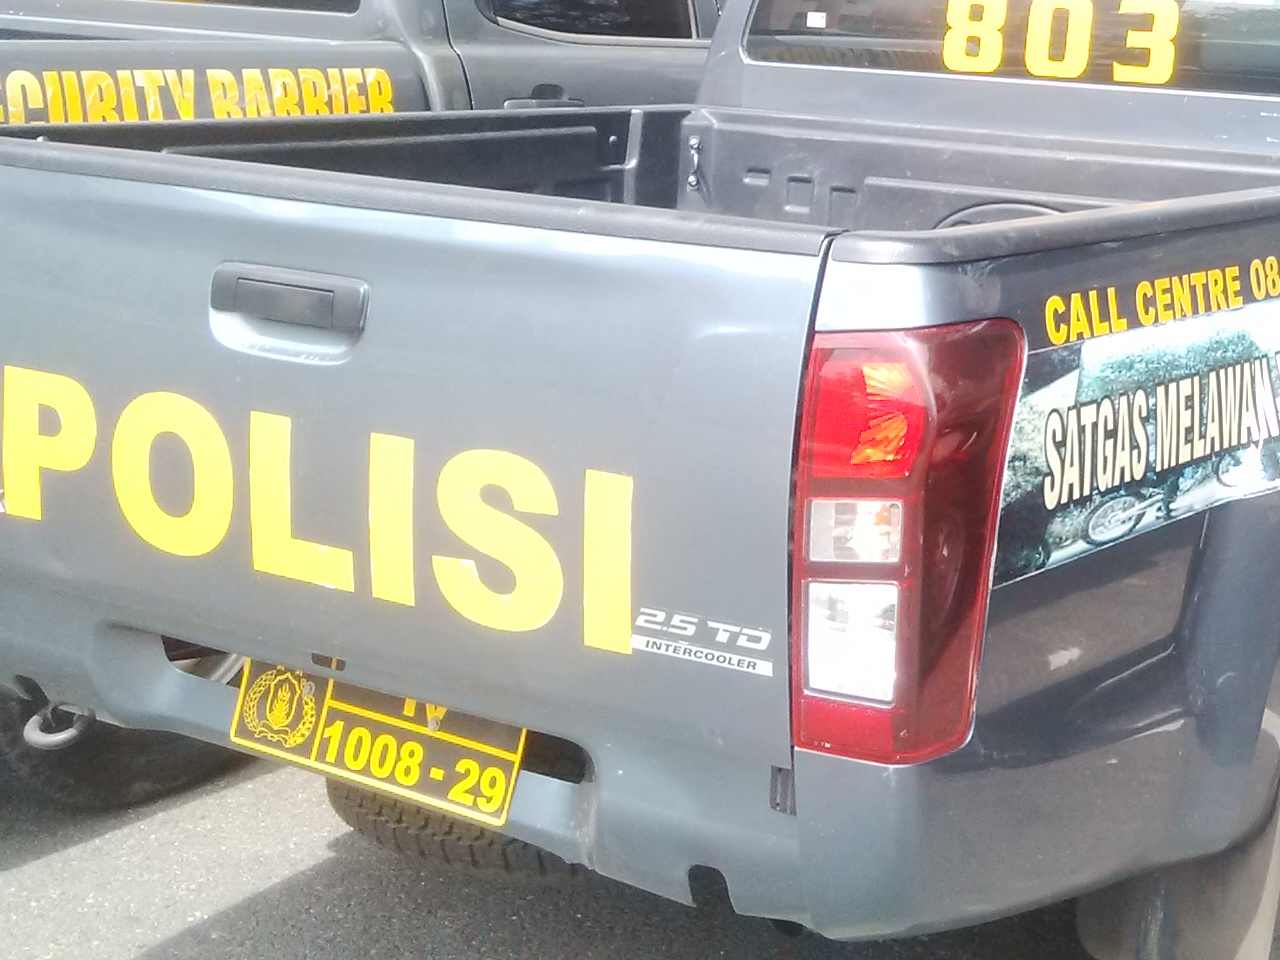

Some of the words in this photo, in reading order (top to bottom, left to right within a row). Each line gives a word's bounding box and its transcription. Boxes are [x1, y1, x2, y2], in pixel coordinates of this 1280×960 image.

[0, 69, 195, 125] CURITY
[206, 67, 394, 120] BARRIER
[1045, 286, 1129, 345] CALL
[1135, 265, 1244, 327] CENTRE
[1043, 388, 1149, 511] SATGAS
[1155, 354, 1280, 472] MELAWAN
[2, 365, 634, 654] POLISI
[634, 607, 699, 636] 2.5
[706, 620, 772, 651] TD
[645, 639, 758, 670] INTERCOOLER
[323, 720, 424, 786] 1008
[447, 758, 507, 813] 29
